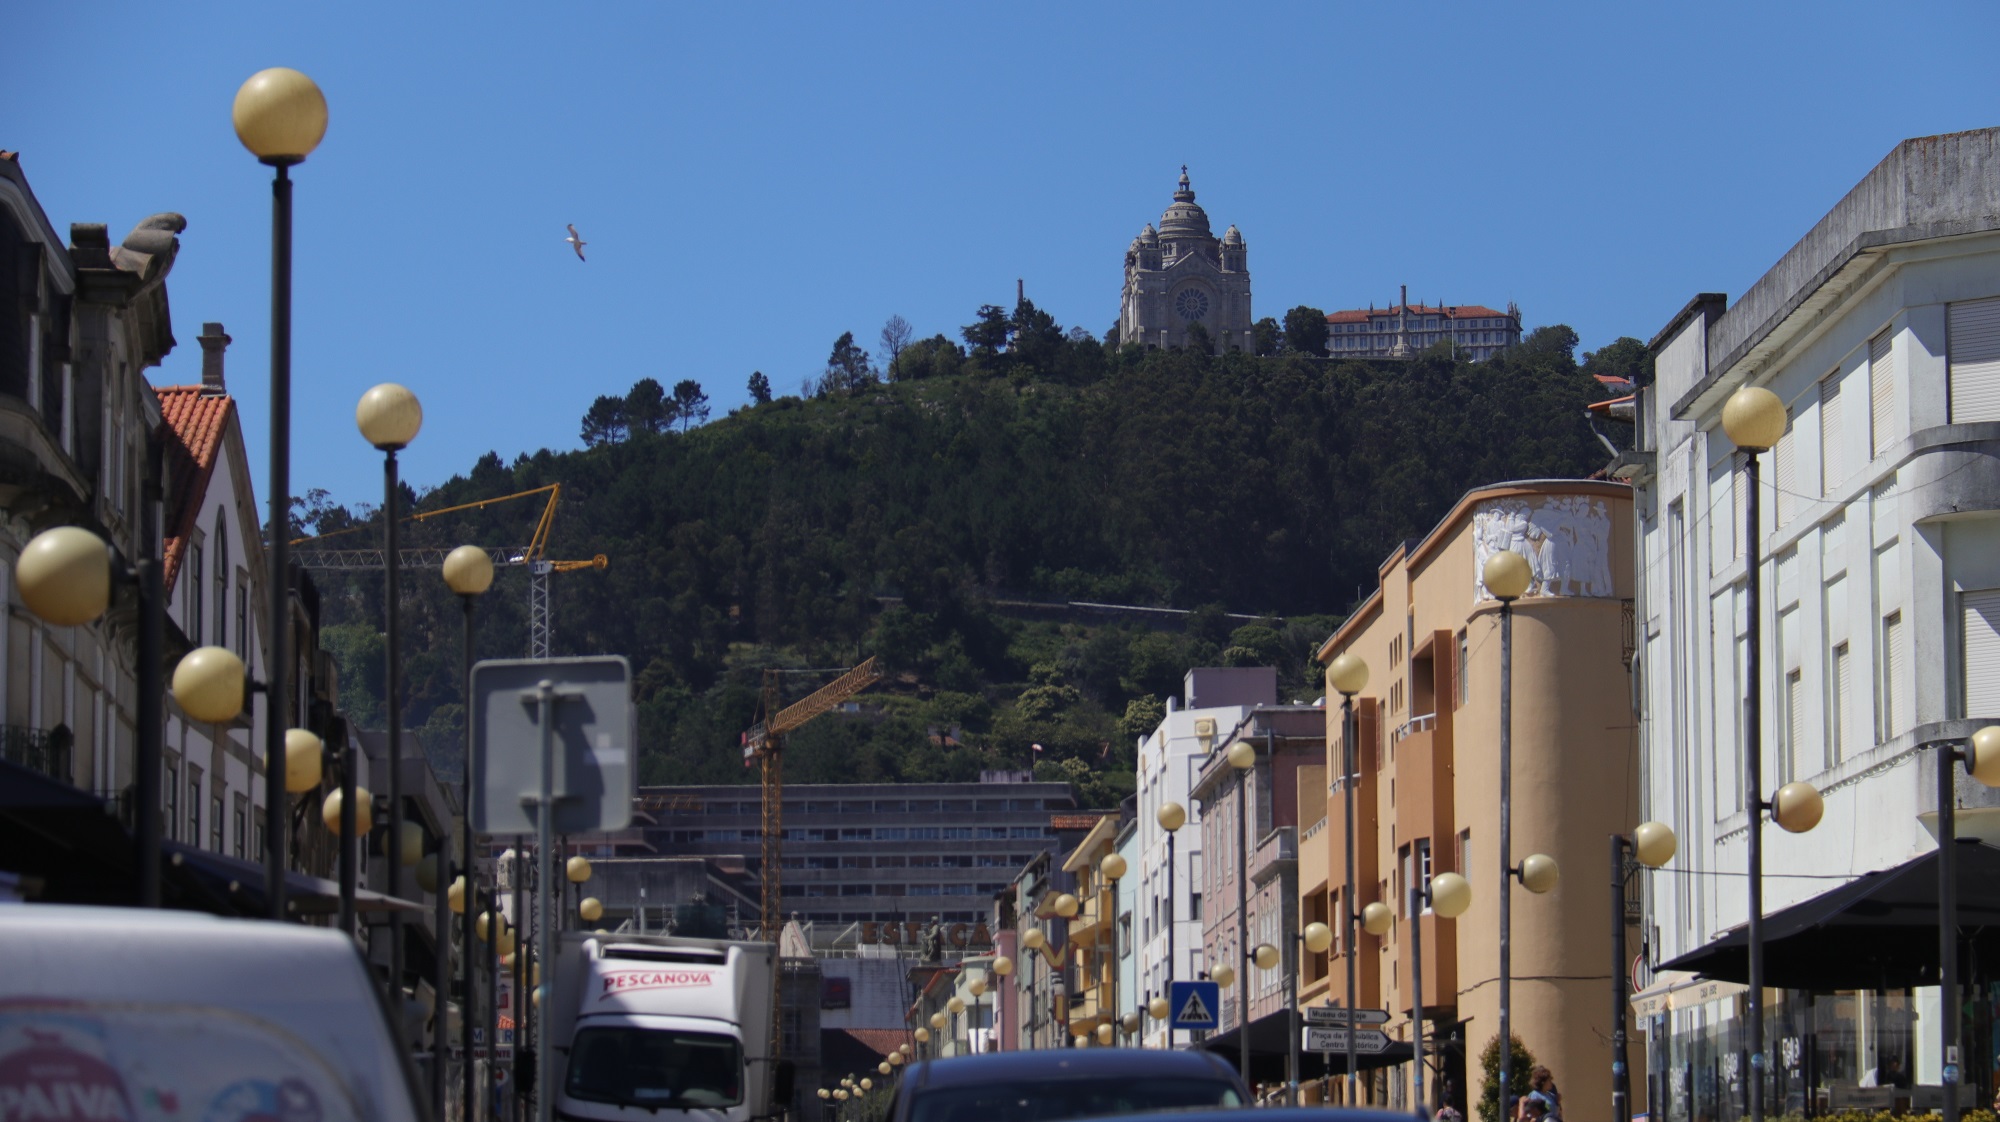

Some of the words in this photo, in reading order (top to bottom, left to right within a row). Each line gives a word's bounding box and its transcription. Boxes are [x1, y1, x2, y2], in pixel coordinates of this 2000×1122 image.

[603, 973, 711, 991] PESCANOVA
[1312, 1010, 1335, 1018] Museu
[1312, 1031, 1332, 1040] Praça
